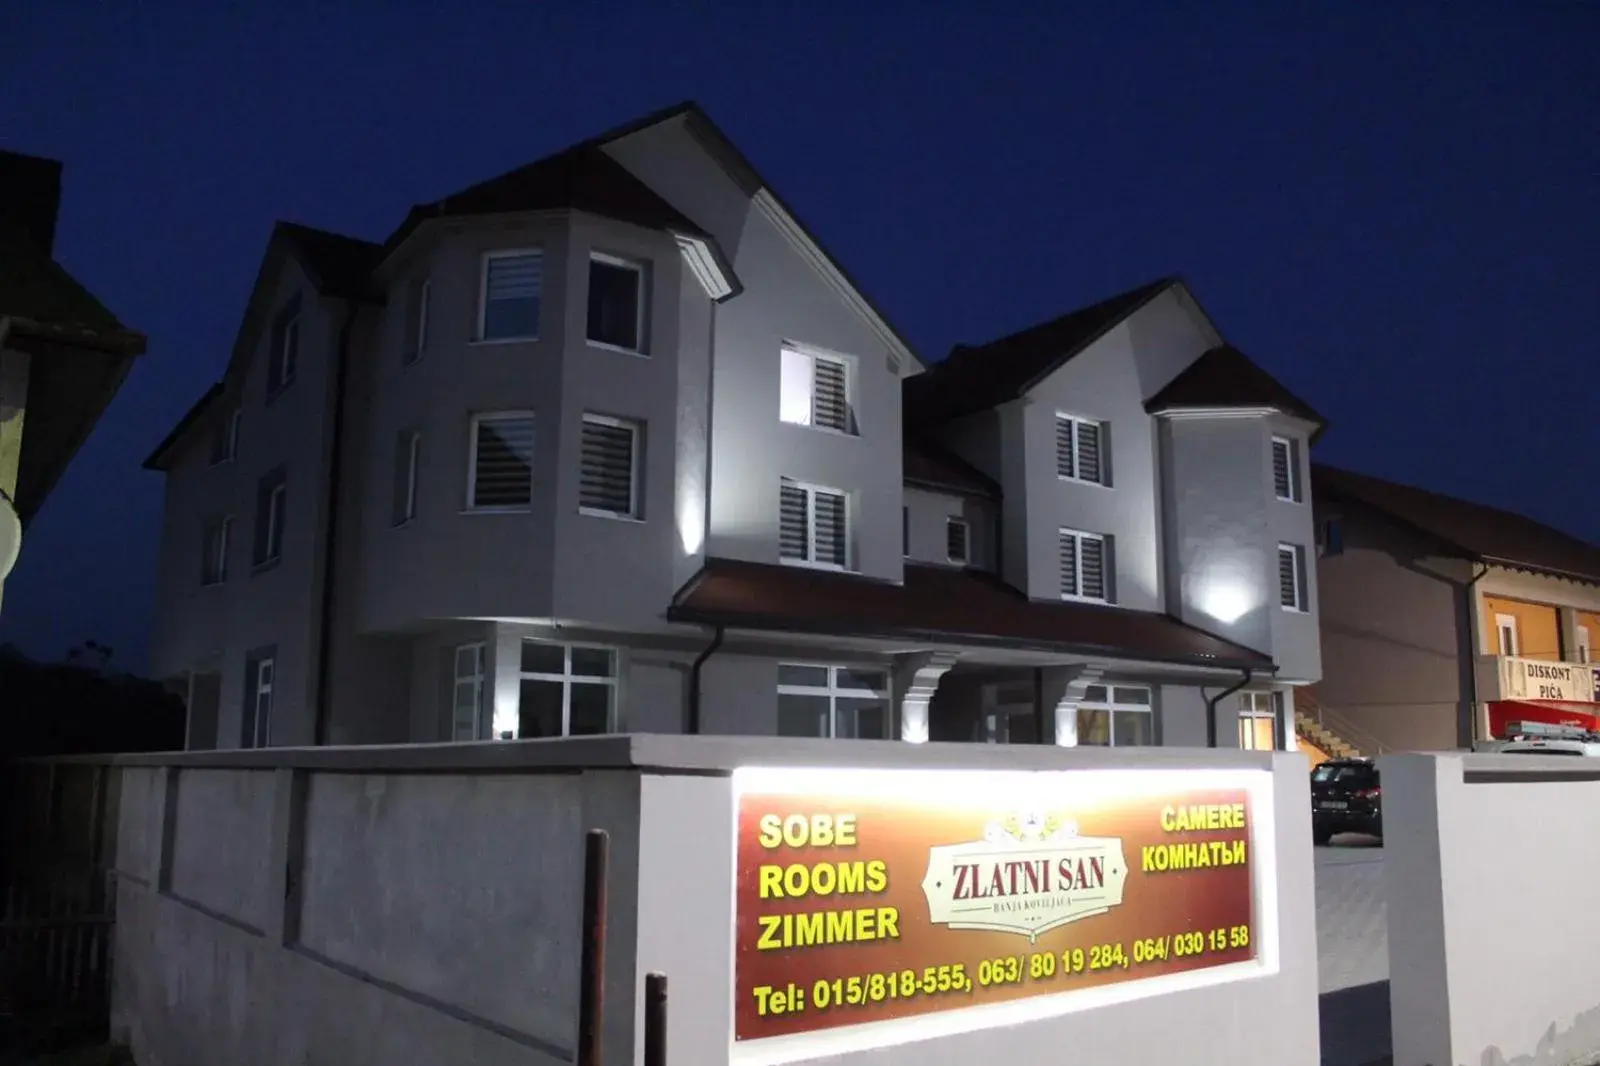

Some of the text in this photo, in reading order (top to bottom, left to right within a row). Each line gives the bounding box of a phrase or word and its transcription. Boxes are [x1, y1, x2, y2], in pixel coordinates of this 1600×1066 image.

[1527, 663, 1571, 681] DISKONT
[759, 814, 857, 848] SOBE
[1161, 803, 1245, 831] CAMERE
[760, 860, 887, 898] ROOMS
[952, 856, 1105, 900] ZLATNI SAN
[757, 907, 900, 949] ZIMMER
[753, 925, 1248, 1015] Tel: 015/818-555, 063/ 80 19 284, 064/ 030 15 58
